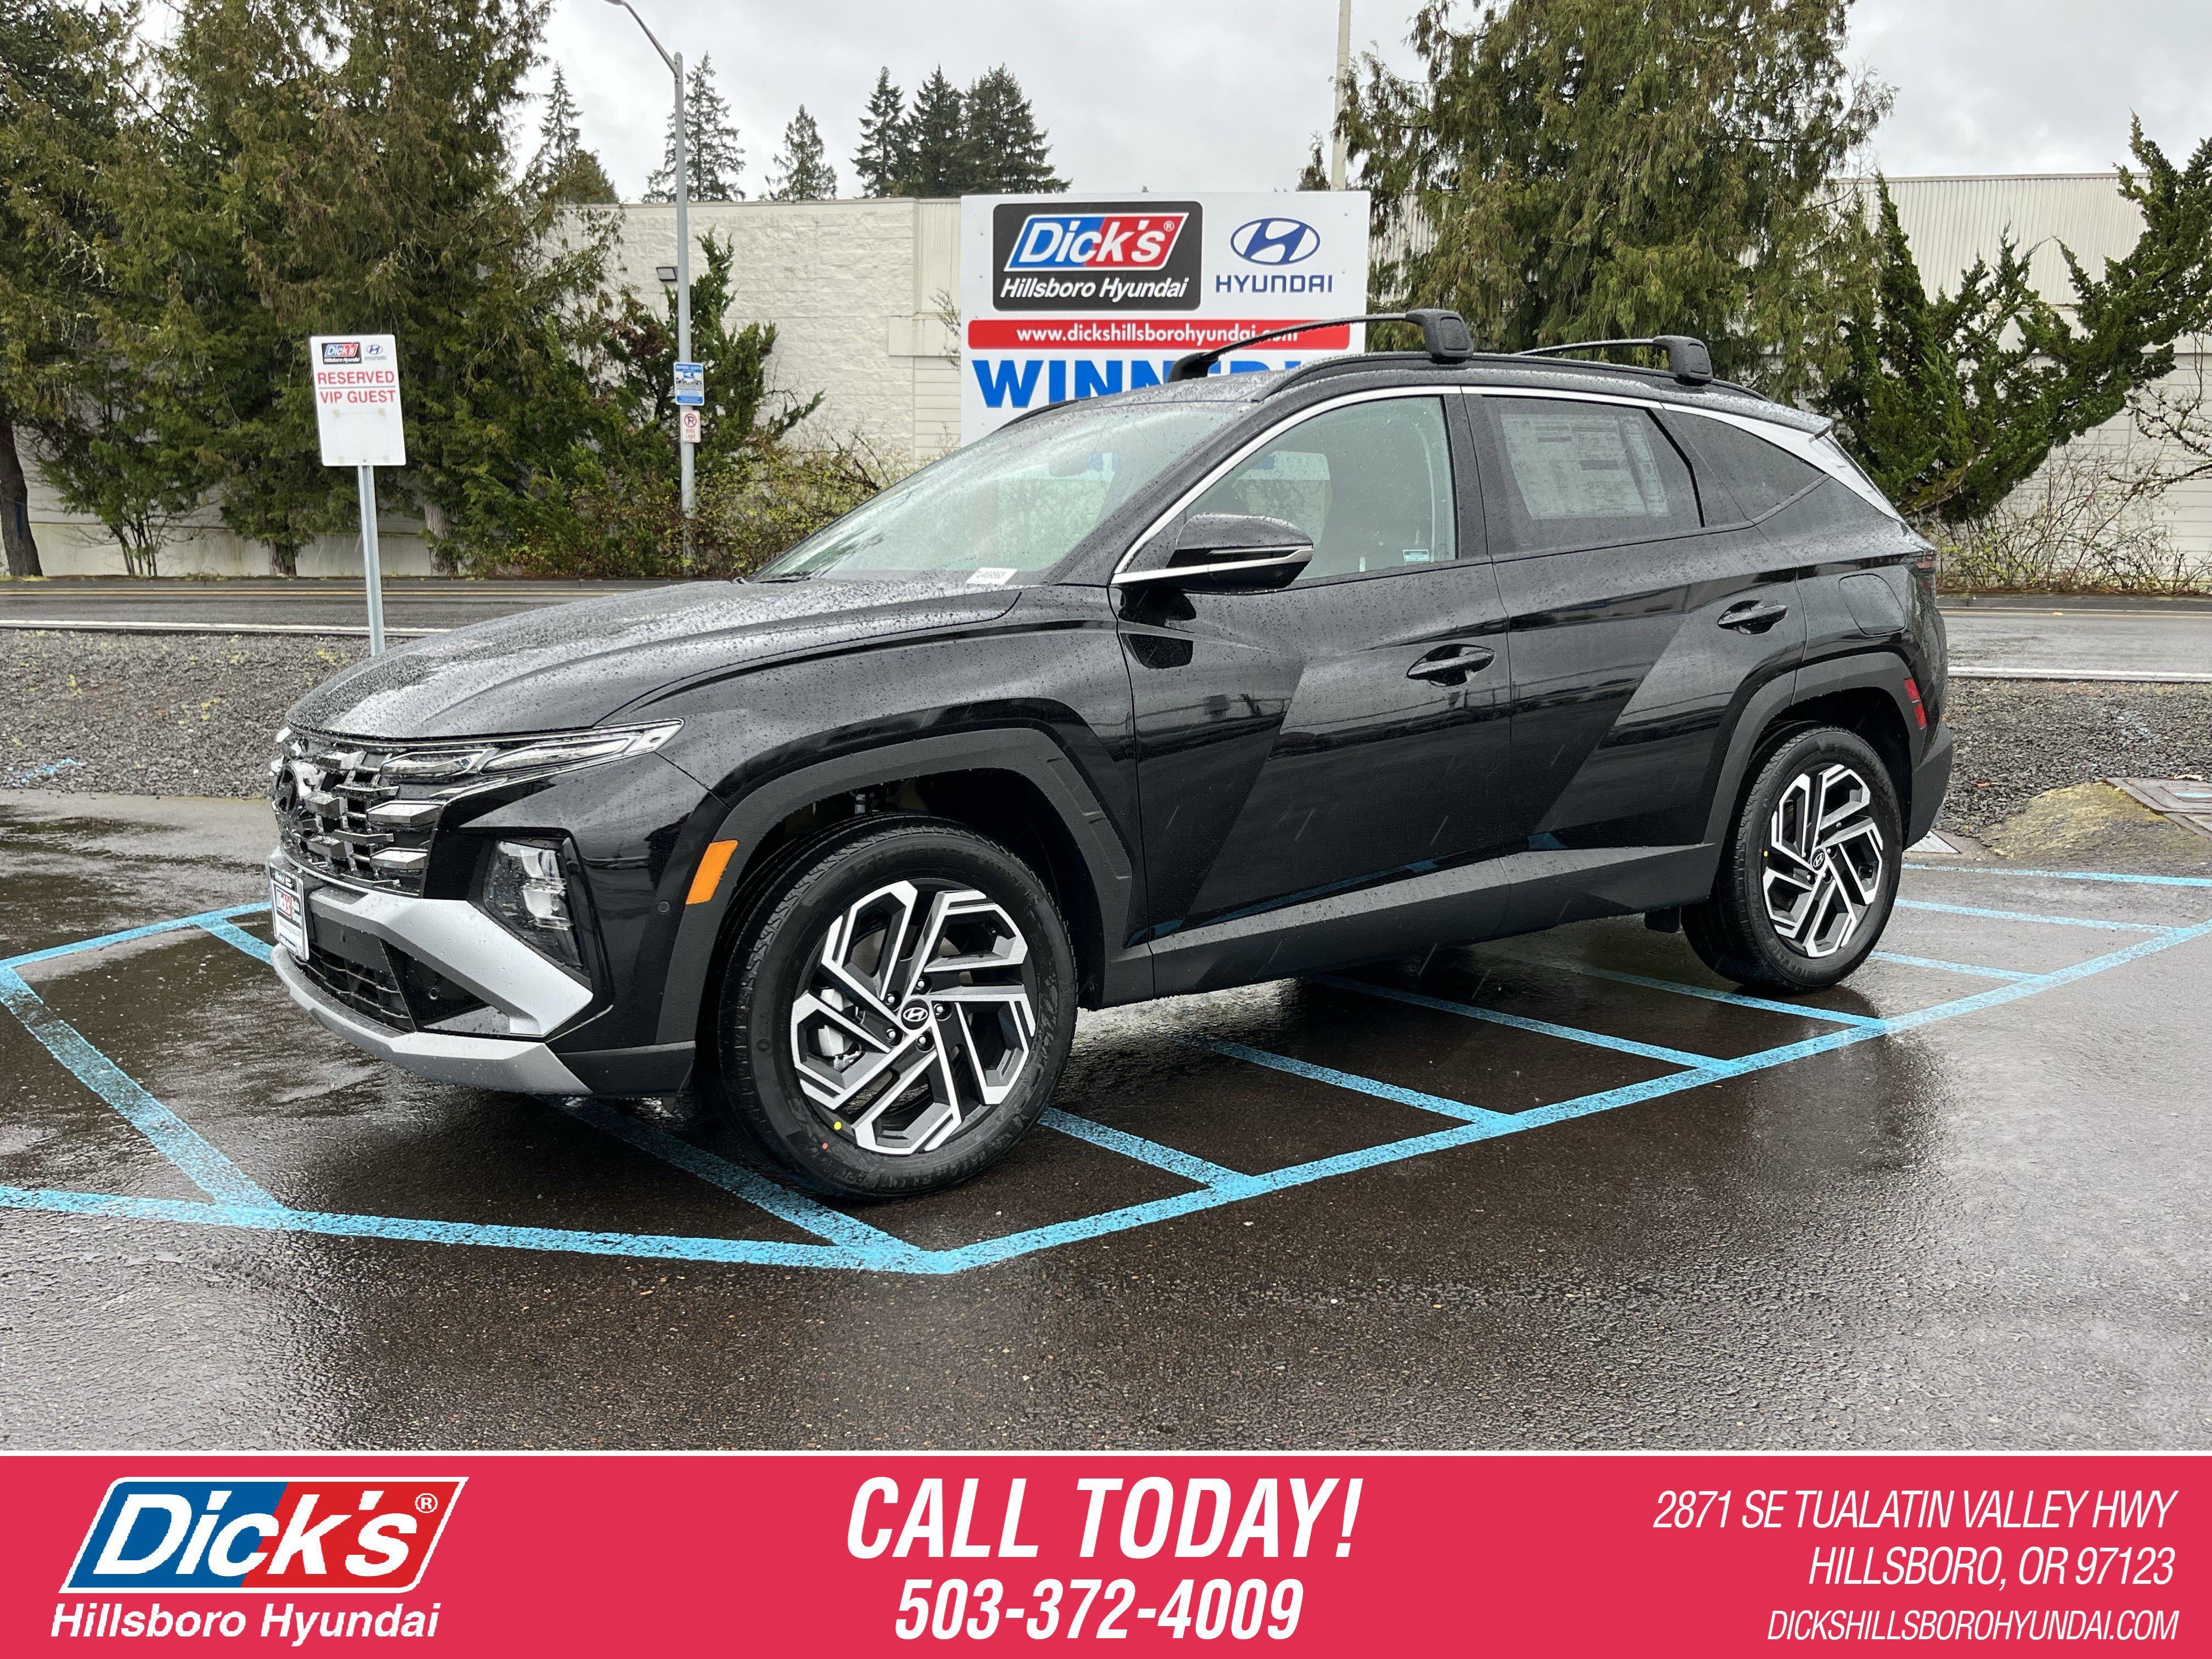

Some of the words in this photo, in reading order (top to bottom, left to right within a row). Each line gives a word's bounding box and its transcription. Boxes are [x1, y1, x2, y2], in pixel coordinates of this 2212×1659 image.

[1001, 277, 1096, 299] Hillsboro
[1099, 277, 1189, 303] Hyundai
[1215, 274, 1333, 293] HYUNDAI
[317, 370, 395, 385] RESERVED
[320, 390, 342, 404] VIP
[348, 390, 396, 404] GUEST
